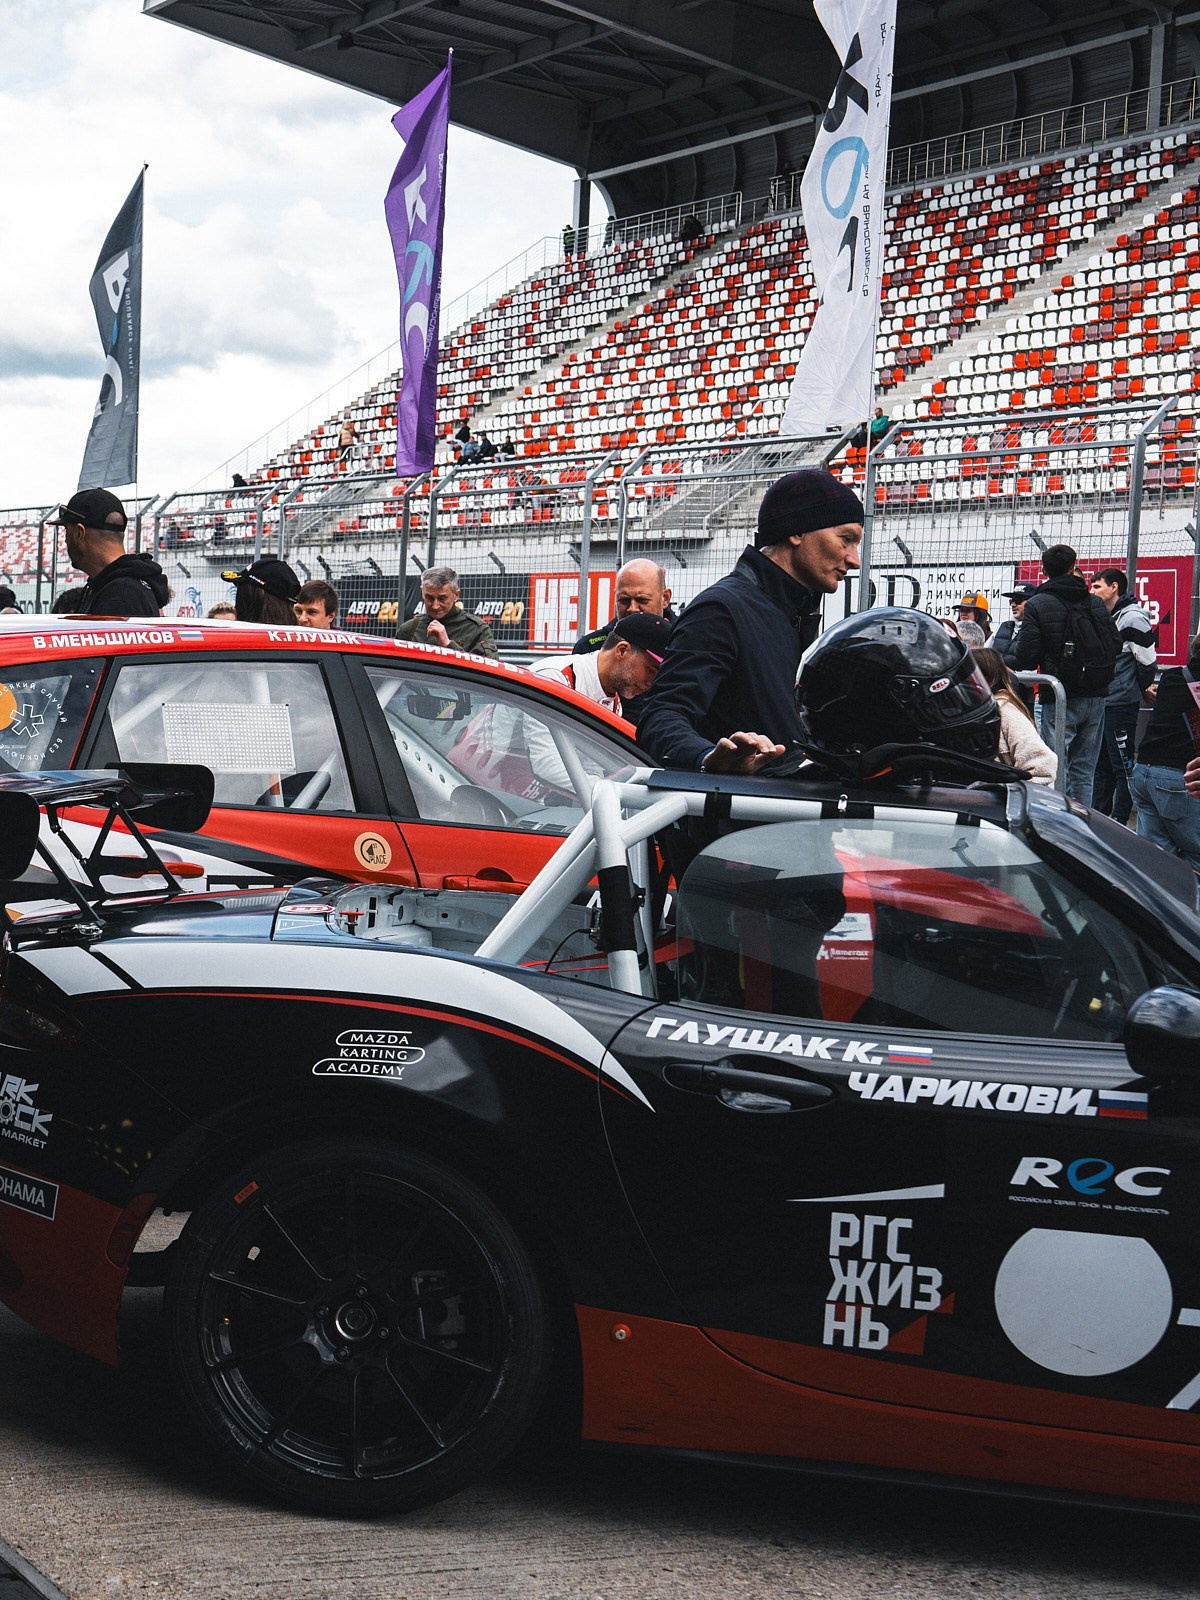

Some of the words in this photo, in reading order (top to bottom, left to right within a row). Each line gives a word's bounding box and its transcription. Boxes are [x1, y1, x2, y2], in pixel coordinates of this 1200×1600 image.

[32, 631, 175, 649] В.МЕНЬШИКОВ
[267, 630, 362, 645] К.ГЛУШАК
[931, 680, 948, 691] BELL
[350, 1033, 409, 1045] MAZDA
[645, 1016, 840, 1060] ГЛУШАК
[841, 1041, 884, 1066] К.
[340, 1047, 408, 1060] KARTING
[326, 1062, 406, 1076] ACADEMY
[1, 1128, 48, 1149] MARKET
[829, 1211, 913, 1264] РГС
[826, 1257, 943, 1311] ЖИЗ
[822, 1303, 890, 1351] НЬ
